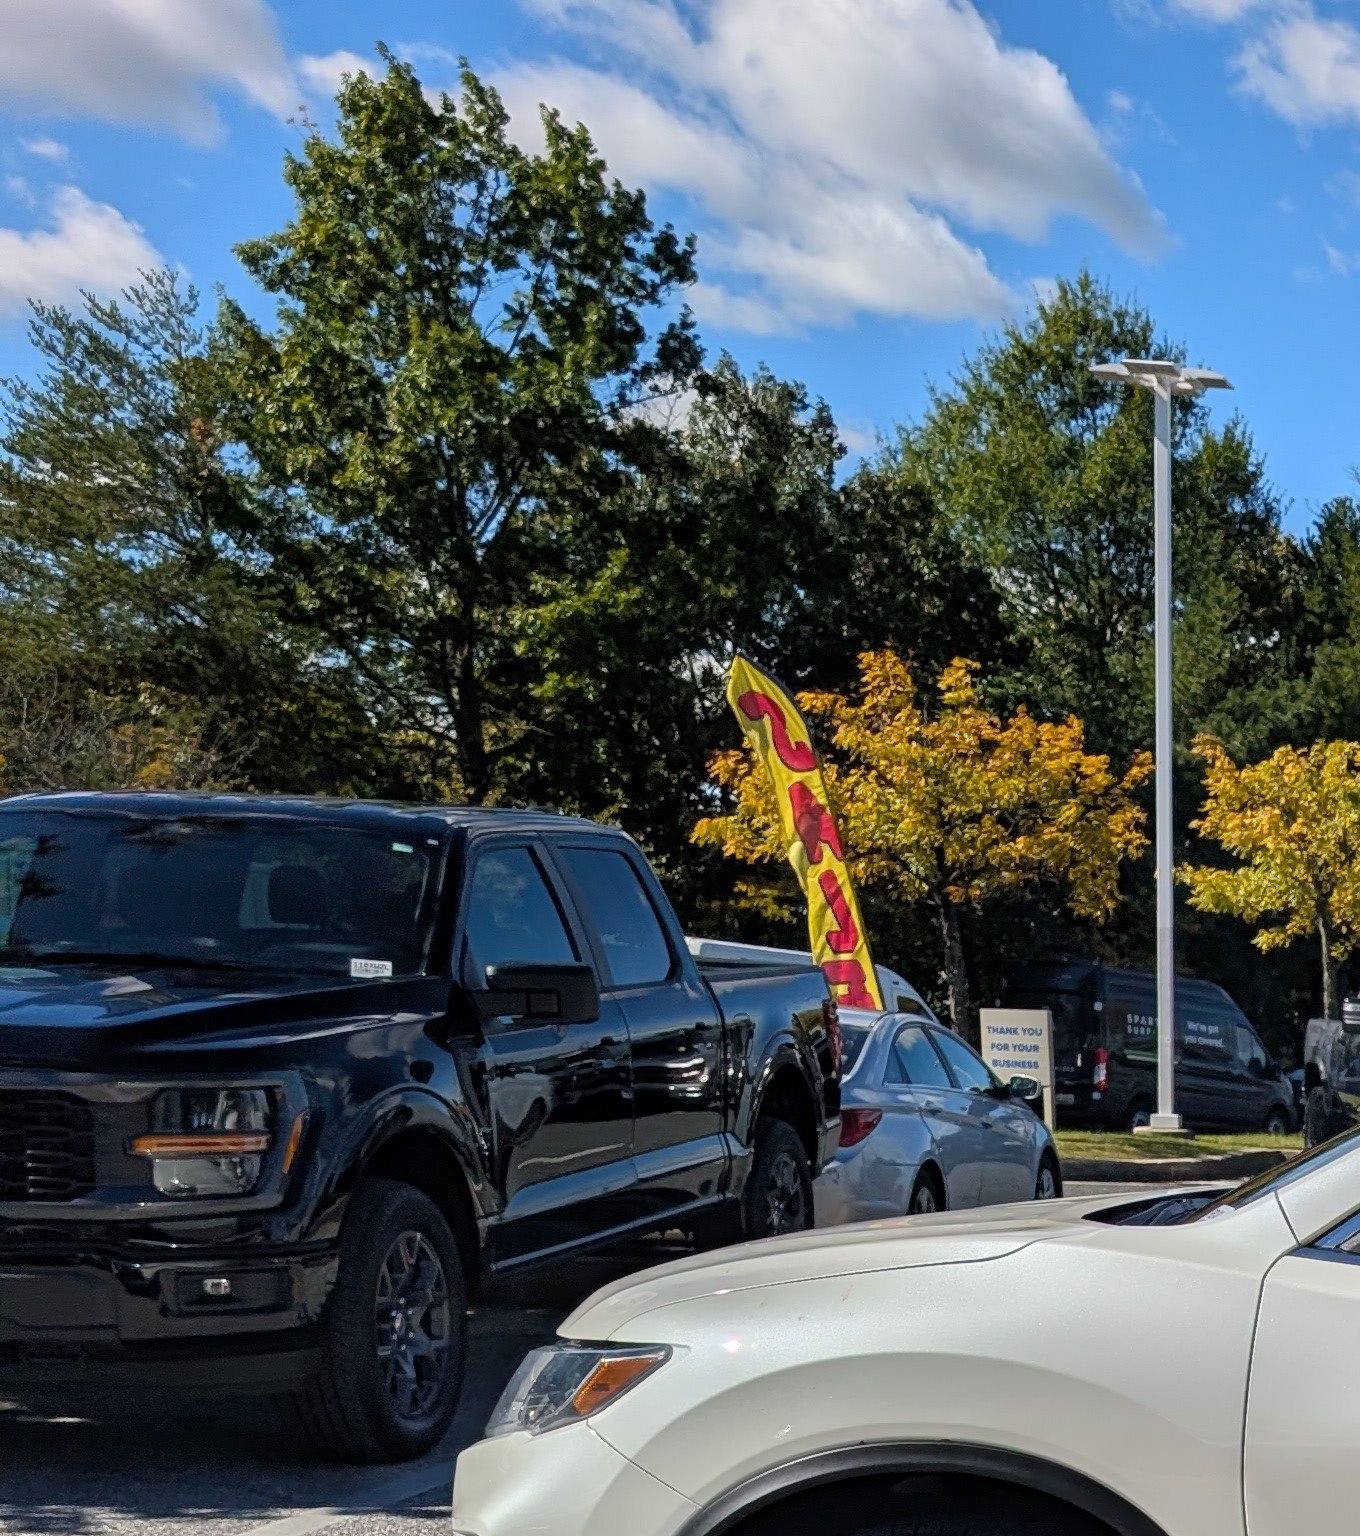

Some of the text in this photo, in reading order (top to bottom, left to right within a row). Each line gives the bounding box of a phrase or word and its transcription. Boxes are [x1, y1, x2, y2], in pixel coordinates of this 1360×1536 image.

[1126, 1013, 1158, 1026] SPAR
[986, 1025, 1043, 1037] THANK YOU
[990, 1042, 1040, 1053] FOR YOUR
[991, 1058, 1040, 1070] BUSINESS
